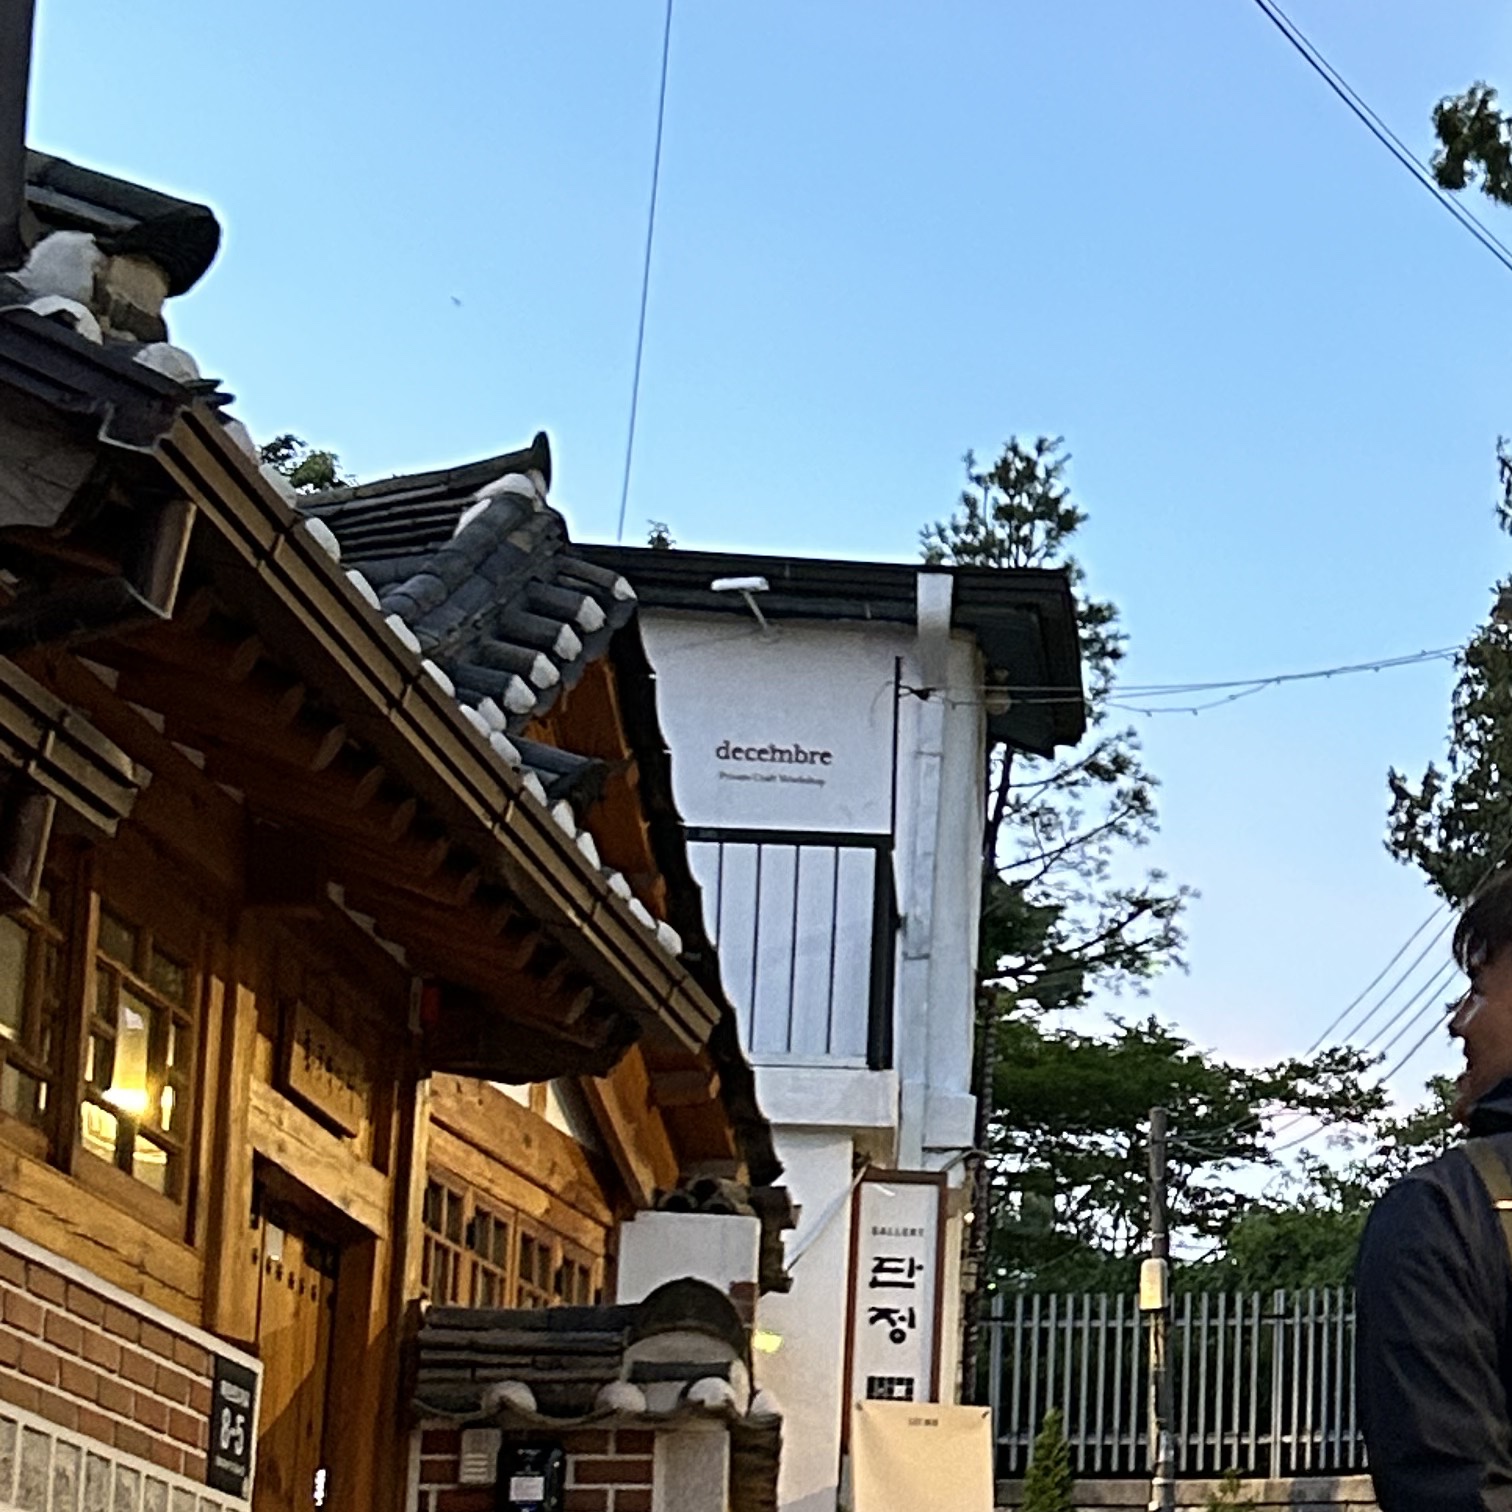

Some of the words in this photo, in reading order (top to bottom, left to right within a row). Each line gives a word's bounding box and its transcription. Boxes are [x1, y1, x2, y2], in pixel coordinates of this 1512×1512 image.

[716, 739, 833, 765] decembre
[872, 1226, 924, 1237] GALLERY
[867, 1255, 924, 1344] 단정
